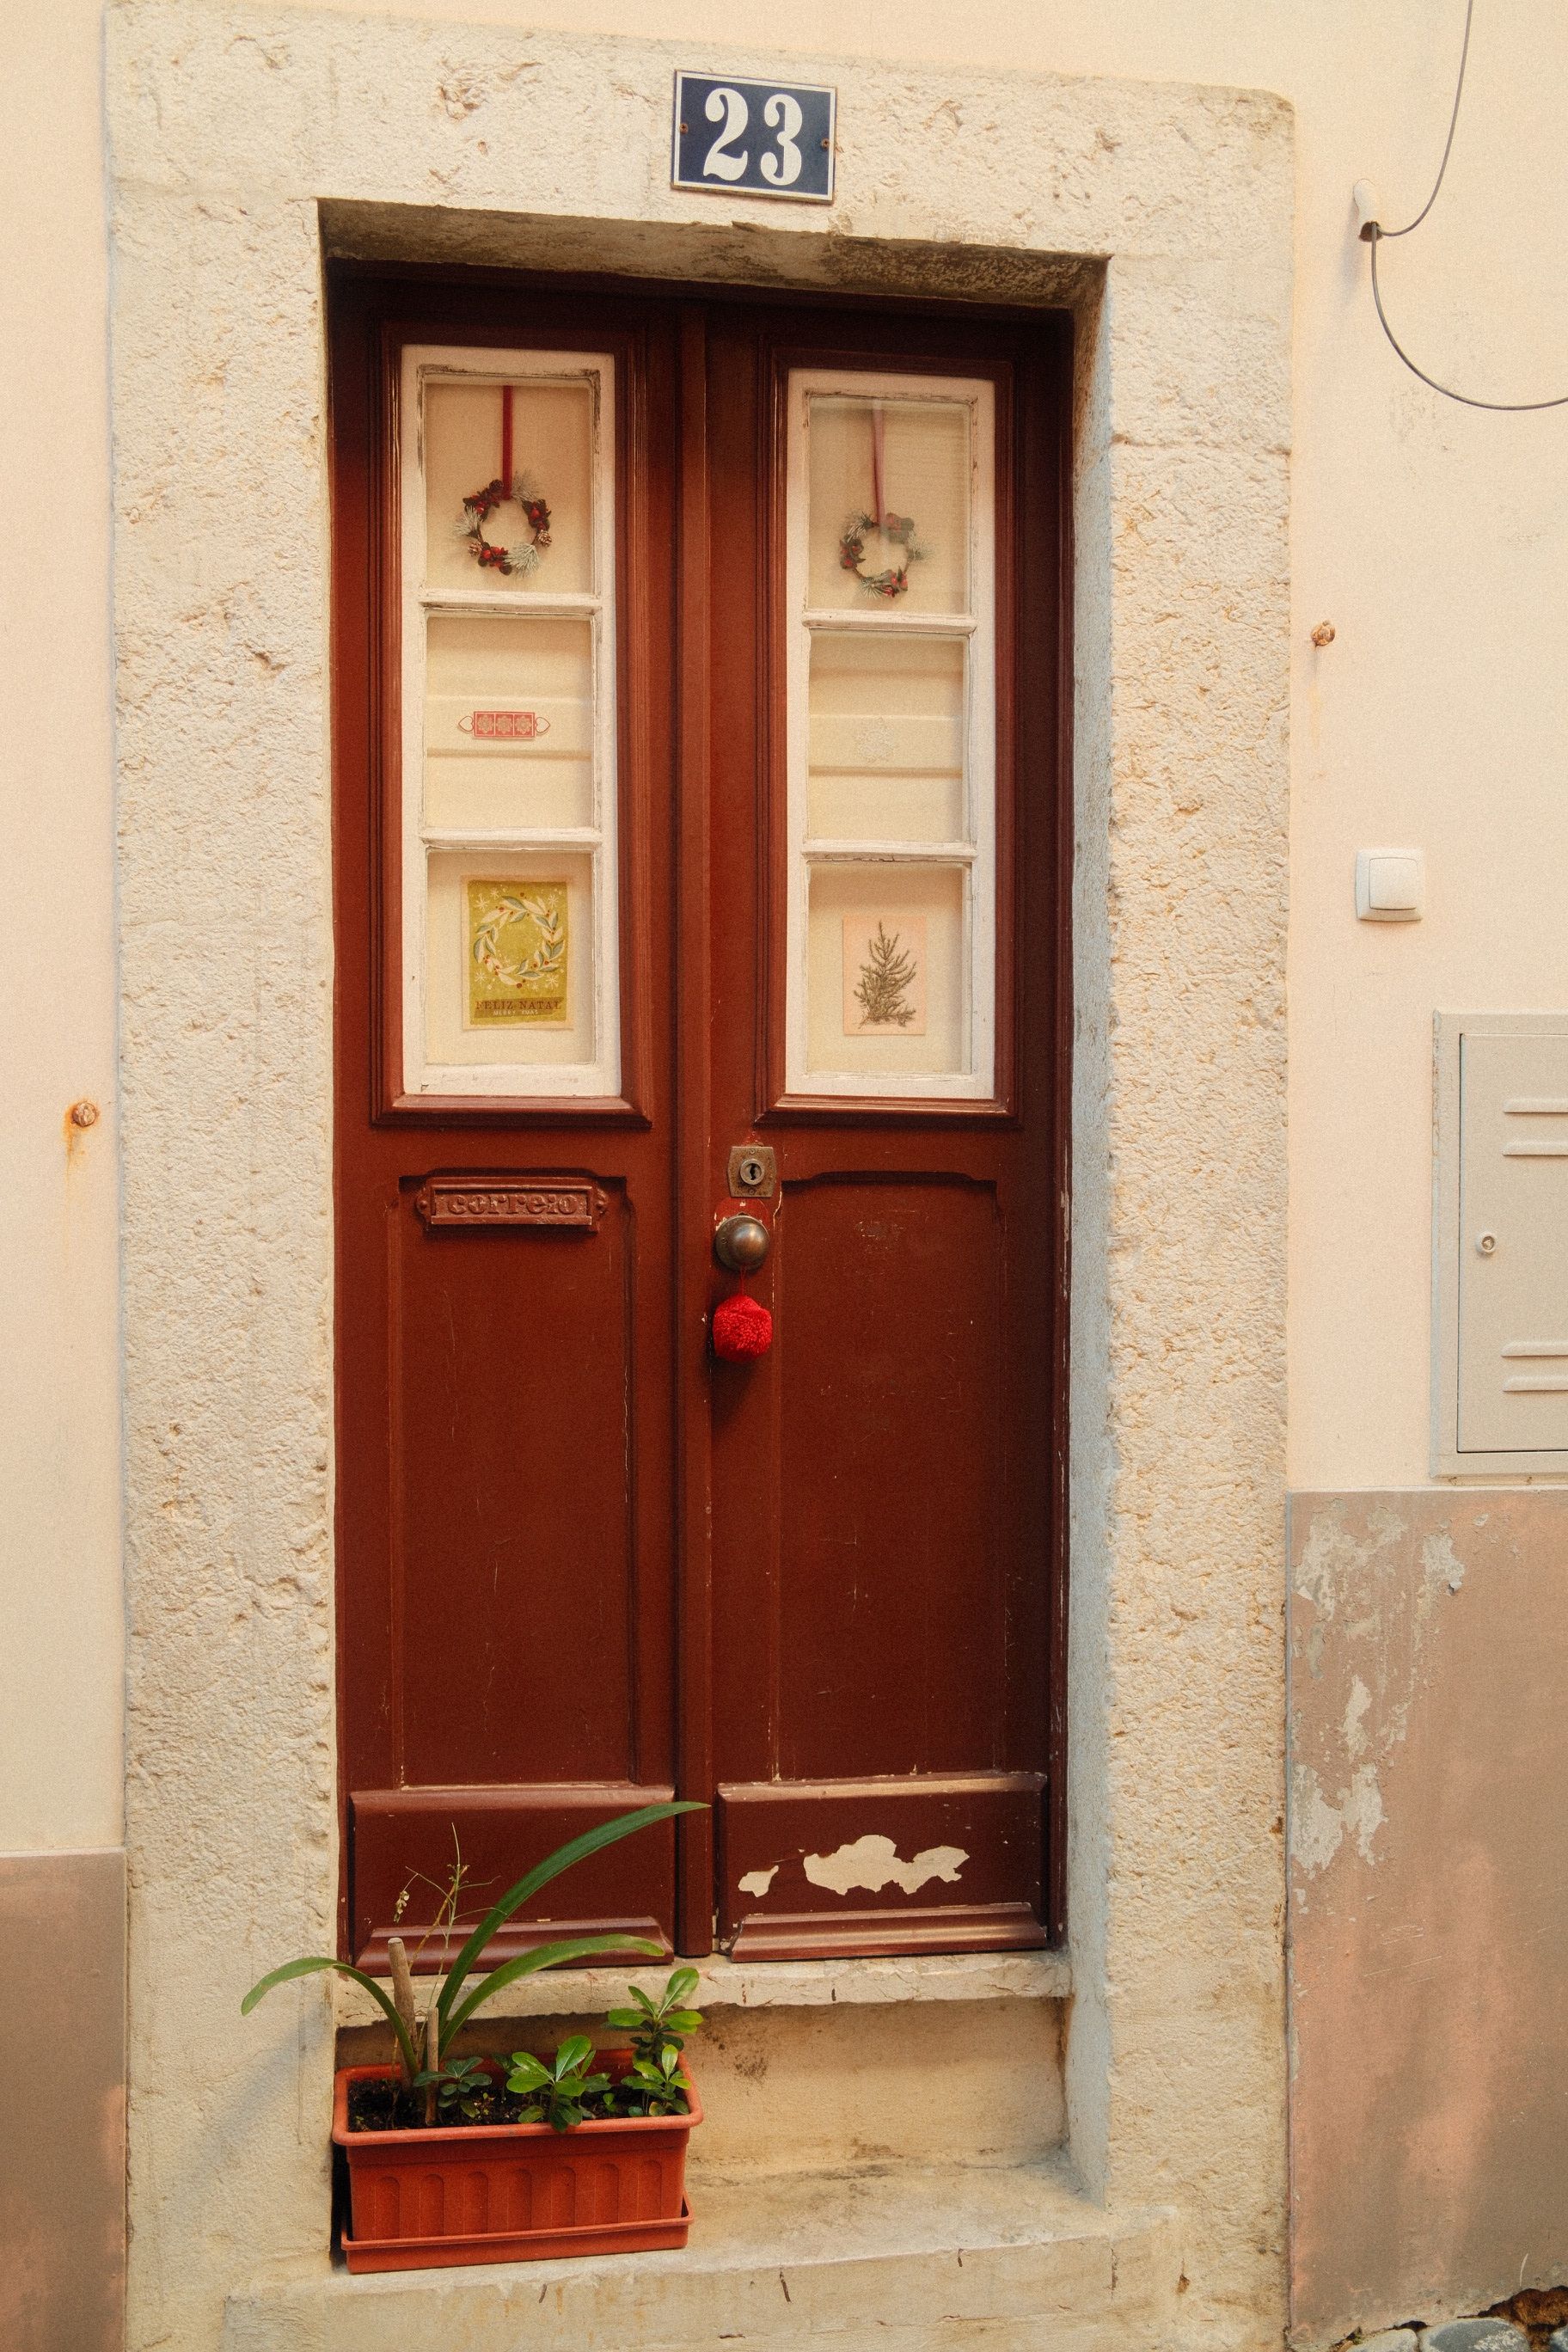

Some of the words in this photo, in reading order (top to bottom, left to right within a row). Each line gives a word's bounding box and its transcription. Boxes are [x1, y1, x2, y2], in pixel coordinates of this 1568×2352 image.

[702, 88, 803, 186] 23
[475, 1001, 513, 1009] FELIZ
[519, 1001, 561, 1009] NATAL
